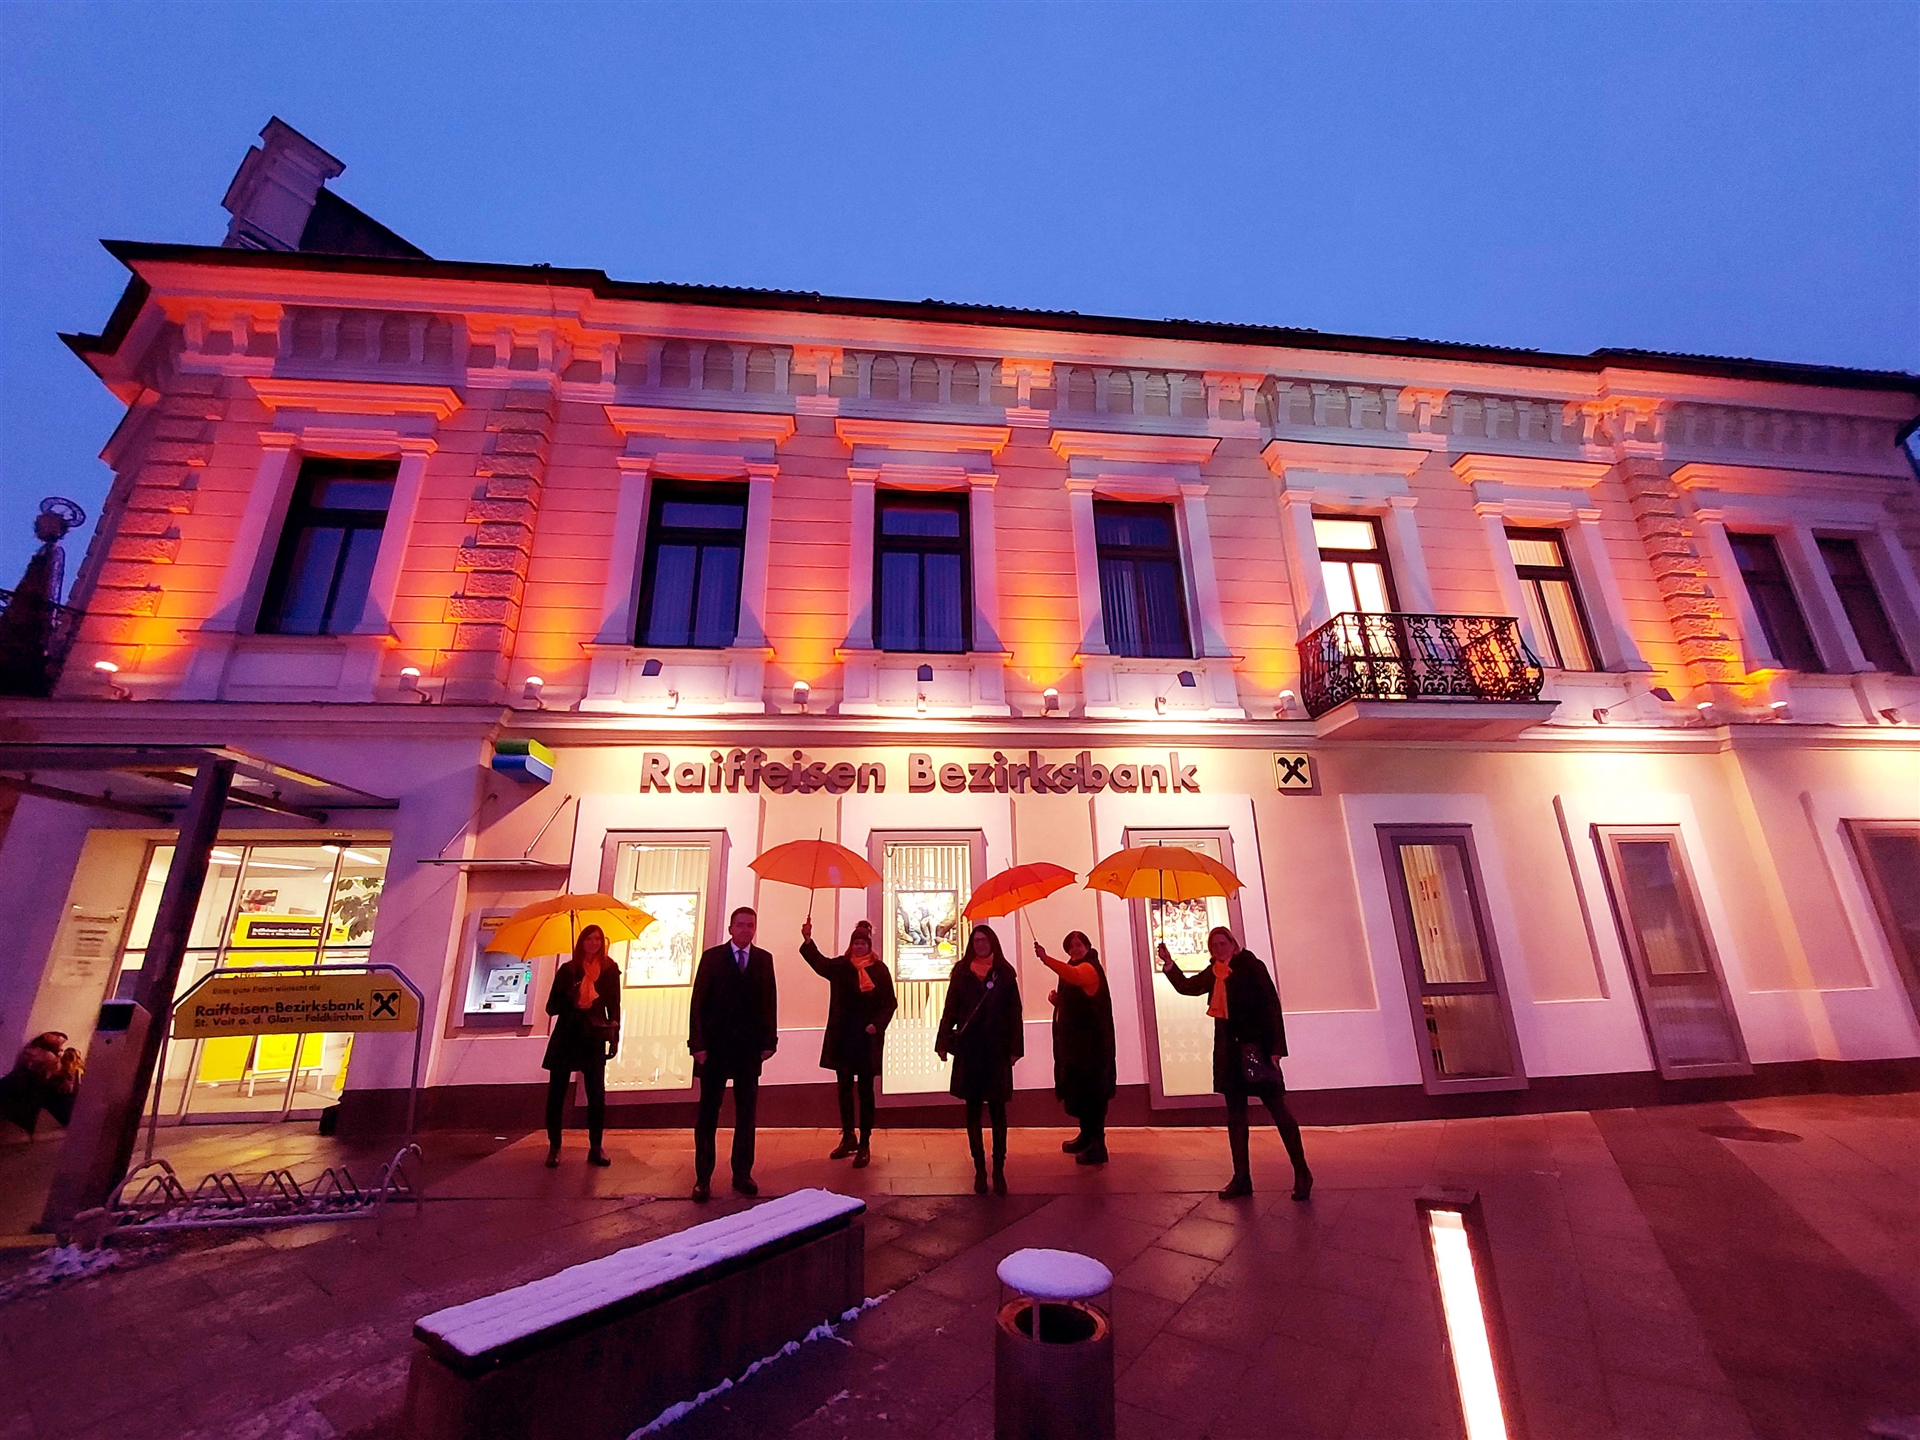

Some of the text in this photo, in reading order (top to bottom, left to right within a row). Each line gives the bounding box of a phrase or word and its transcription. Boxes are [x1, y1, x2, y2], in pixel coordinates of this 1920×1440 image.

[640, 748, 1201, 793] Raiffeisen Bezirksbank
[195, 998, 364, 1017] Raiffeisen-Bezirksbank
[195, 1018, 208, 1028] St.
[213, 1017, 235, 1026] Veit
[267, 1014, 293, 1025] Glan
[305, 1012, 364, 1022] Feldkirchen
